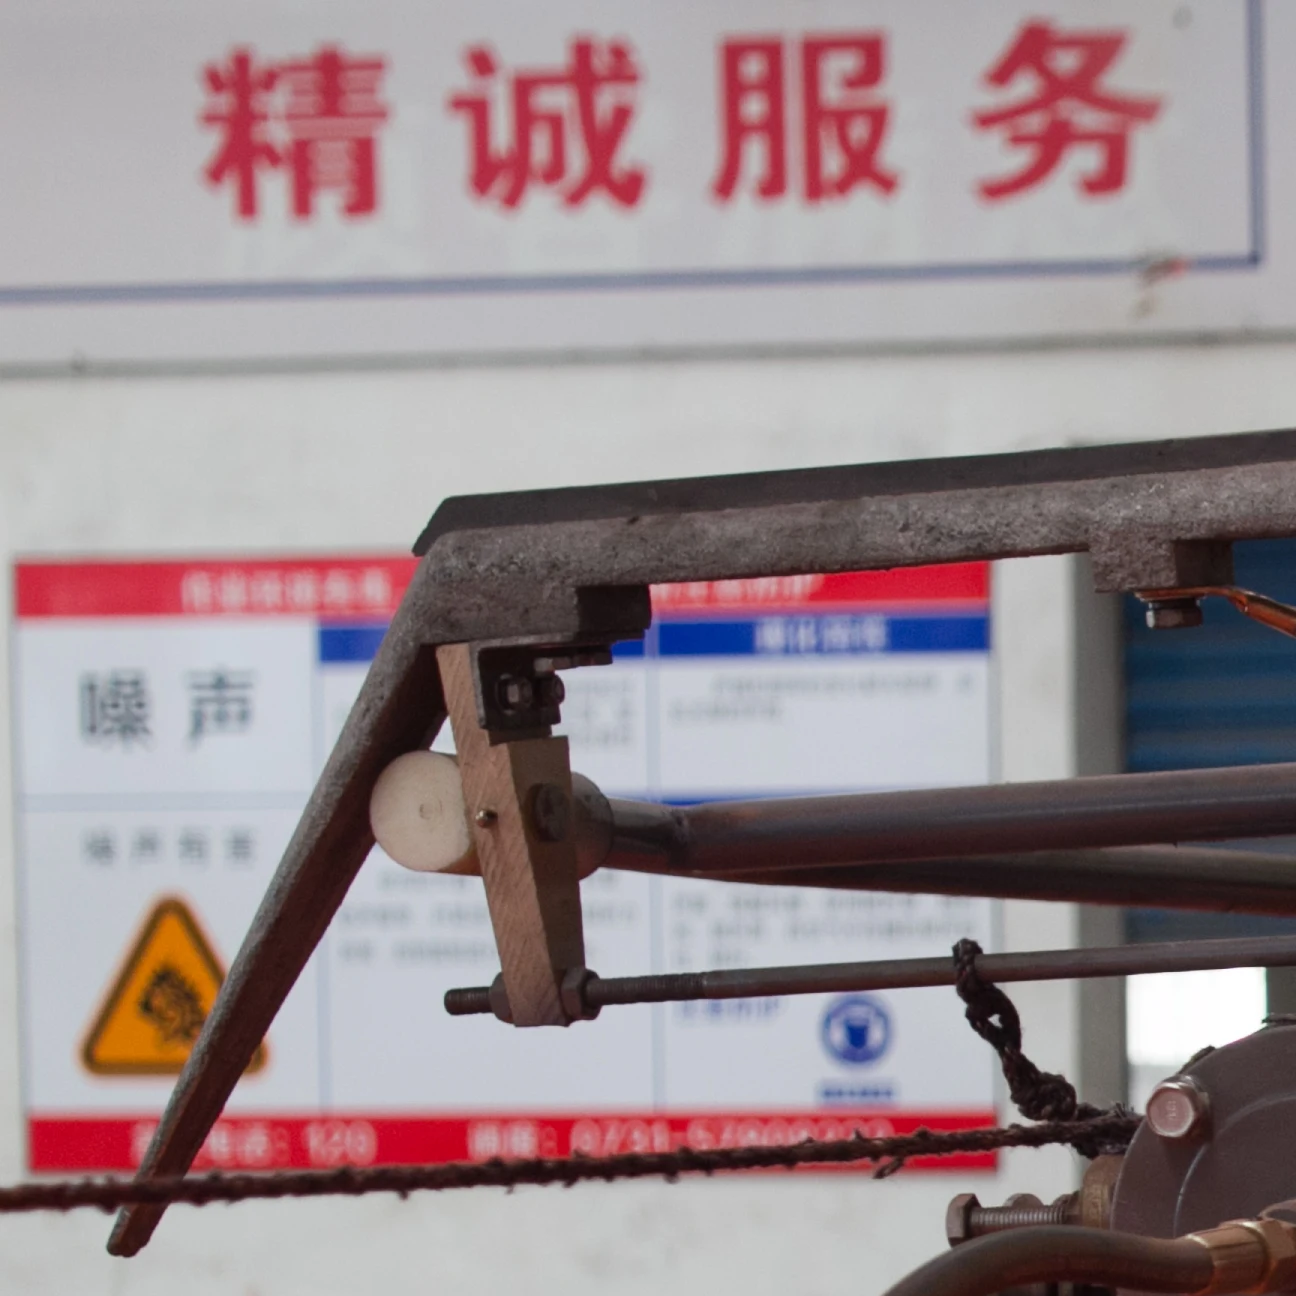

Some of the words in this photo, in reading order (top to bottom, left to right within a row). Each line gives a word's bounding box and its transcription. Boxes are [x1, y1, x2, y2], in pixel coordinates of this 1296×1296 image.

[200, 18, 1164, 221] 精诚服务
[80, 671, 254, 746] 噪声
